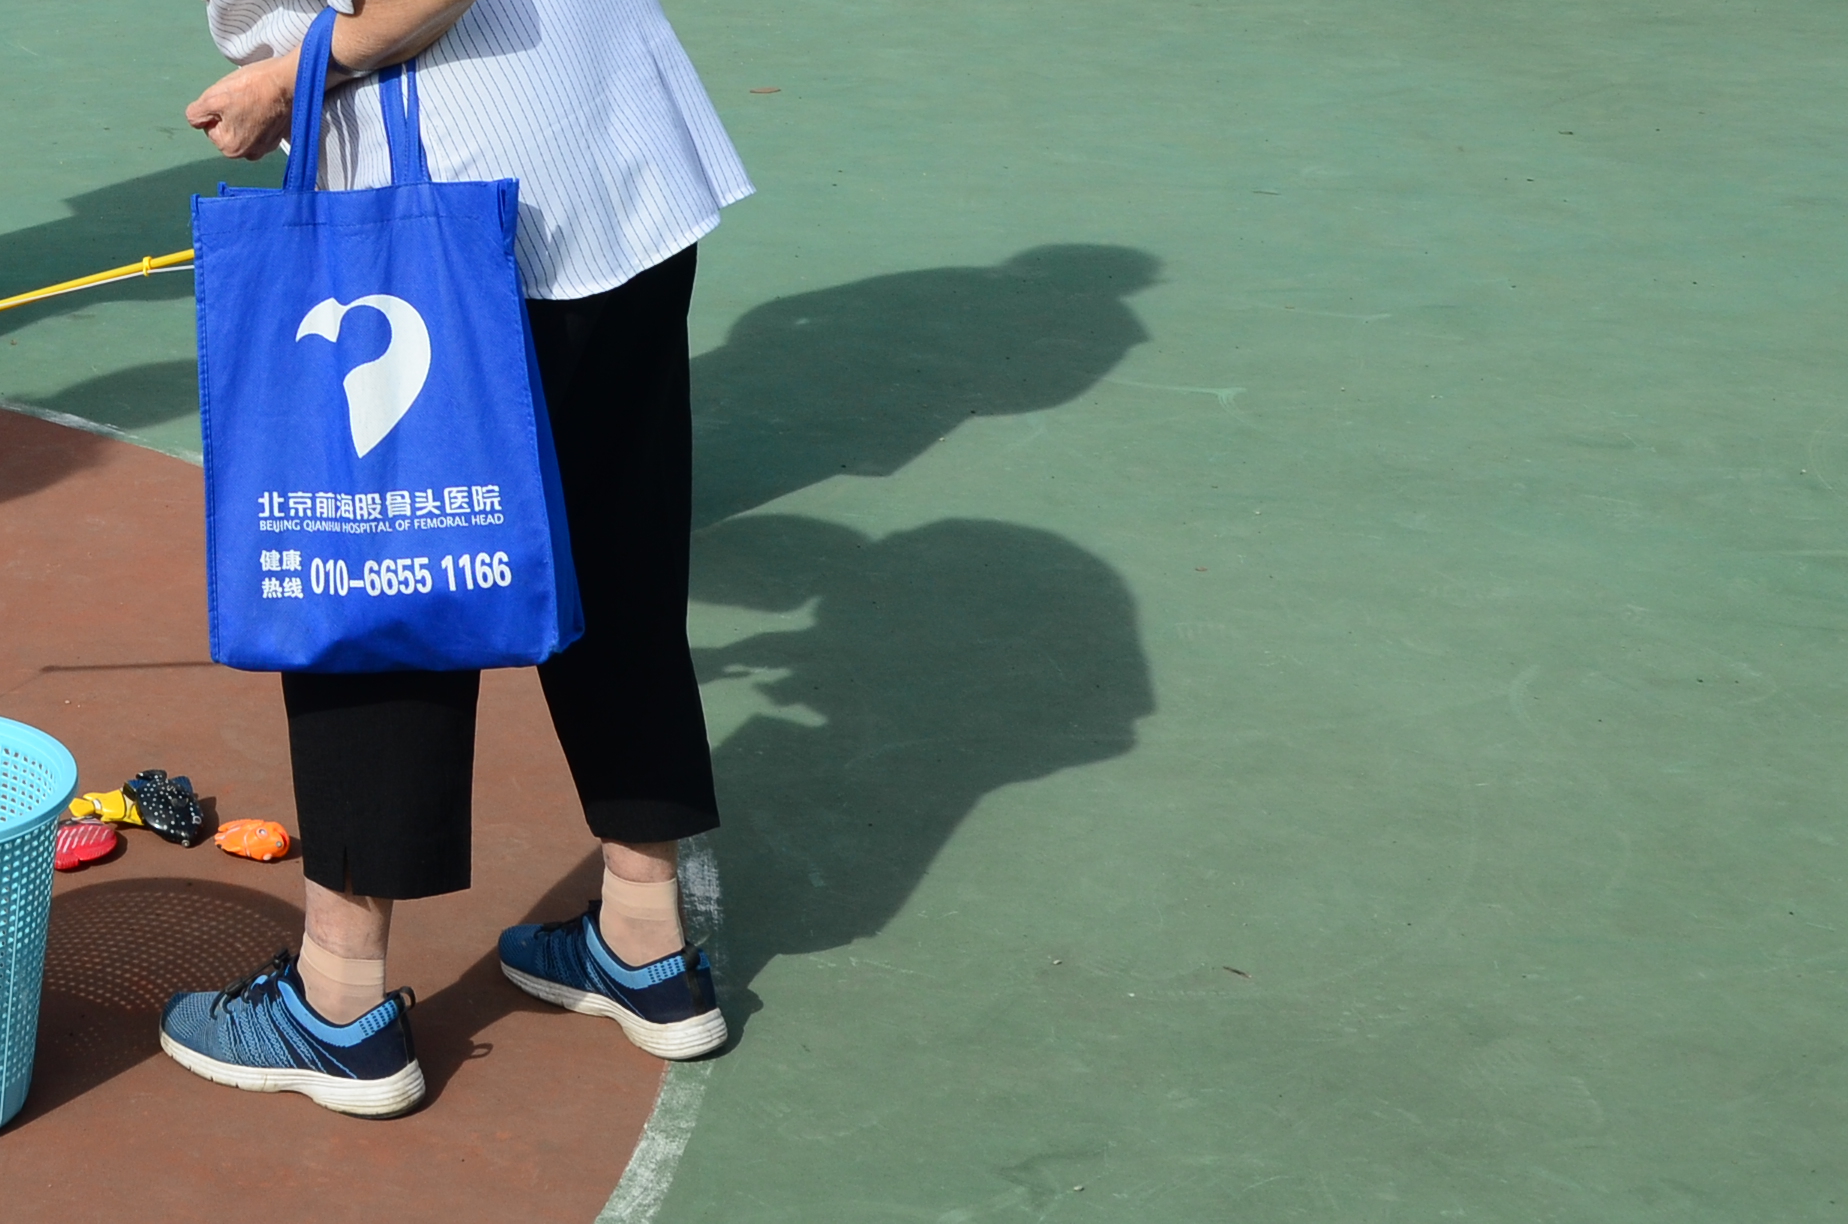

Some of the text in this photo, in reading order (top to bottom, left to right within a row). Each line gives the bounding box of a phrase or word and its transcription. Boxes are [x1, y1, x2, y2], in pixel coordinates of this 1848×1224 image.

[257, 484, 503, 520] 北京前海股骨头医院
[259, 513, 504, 534] BEIJING QIANHAI HOSPITAL OF FEMORAL HEAD
[259, 549, 302, 572] 健康
[310, 550, 512, 597] 010-6655 1166
[261, 576, 304, 599] 热线
